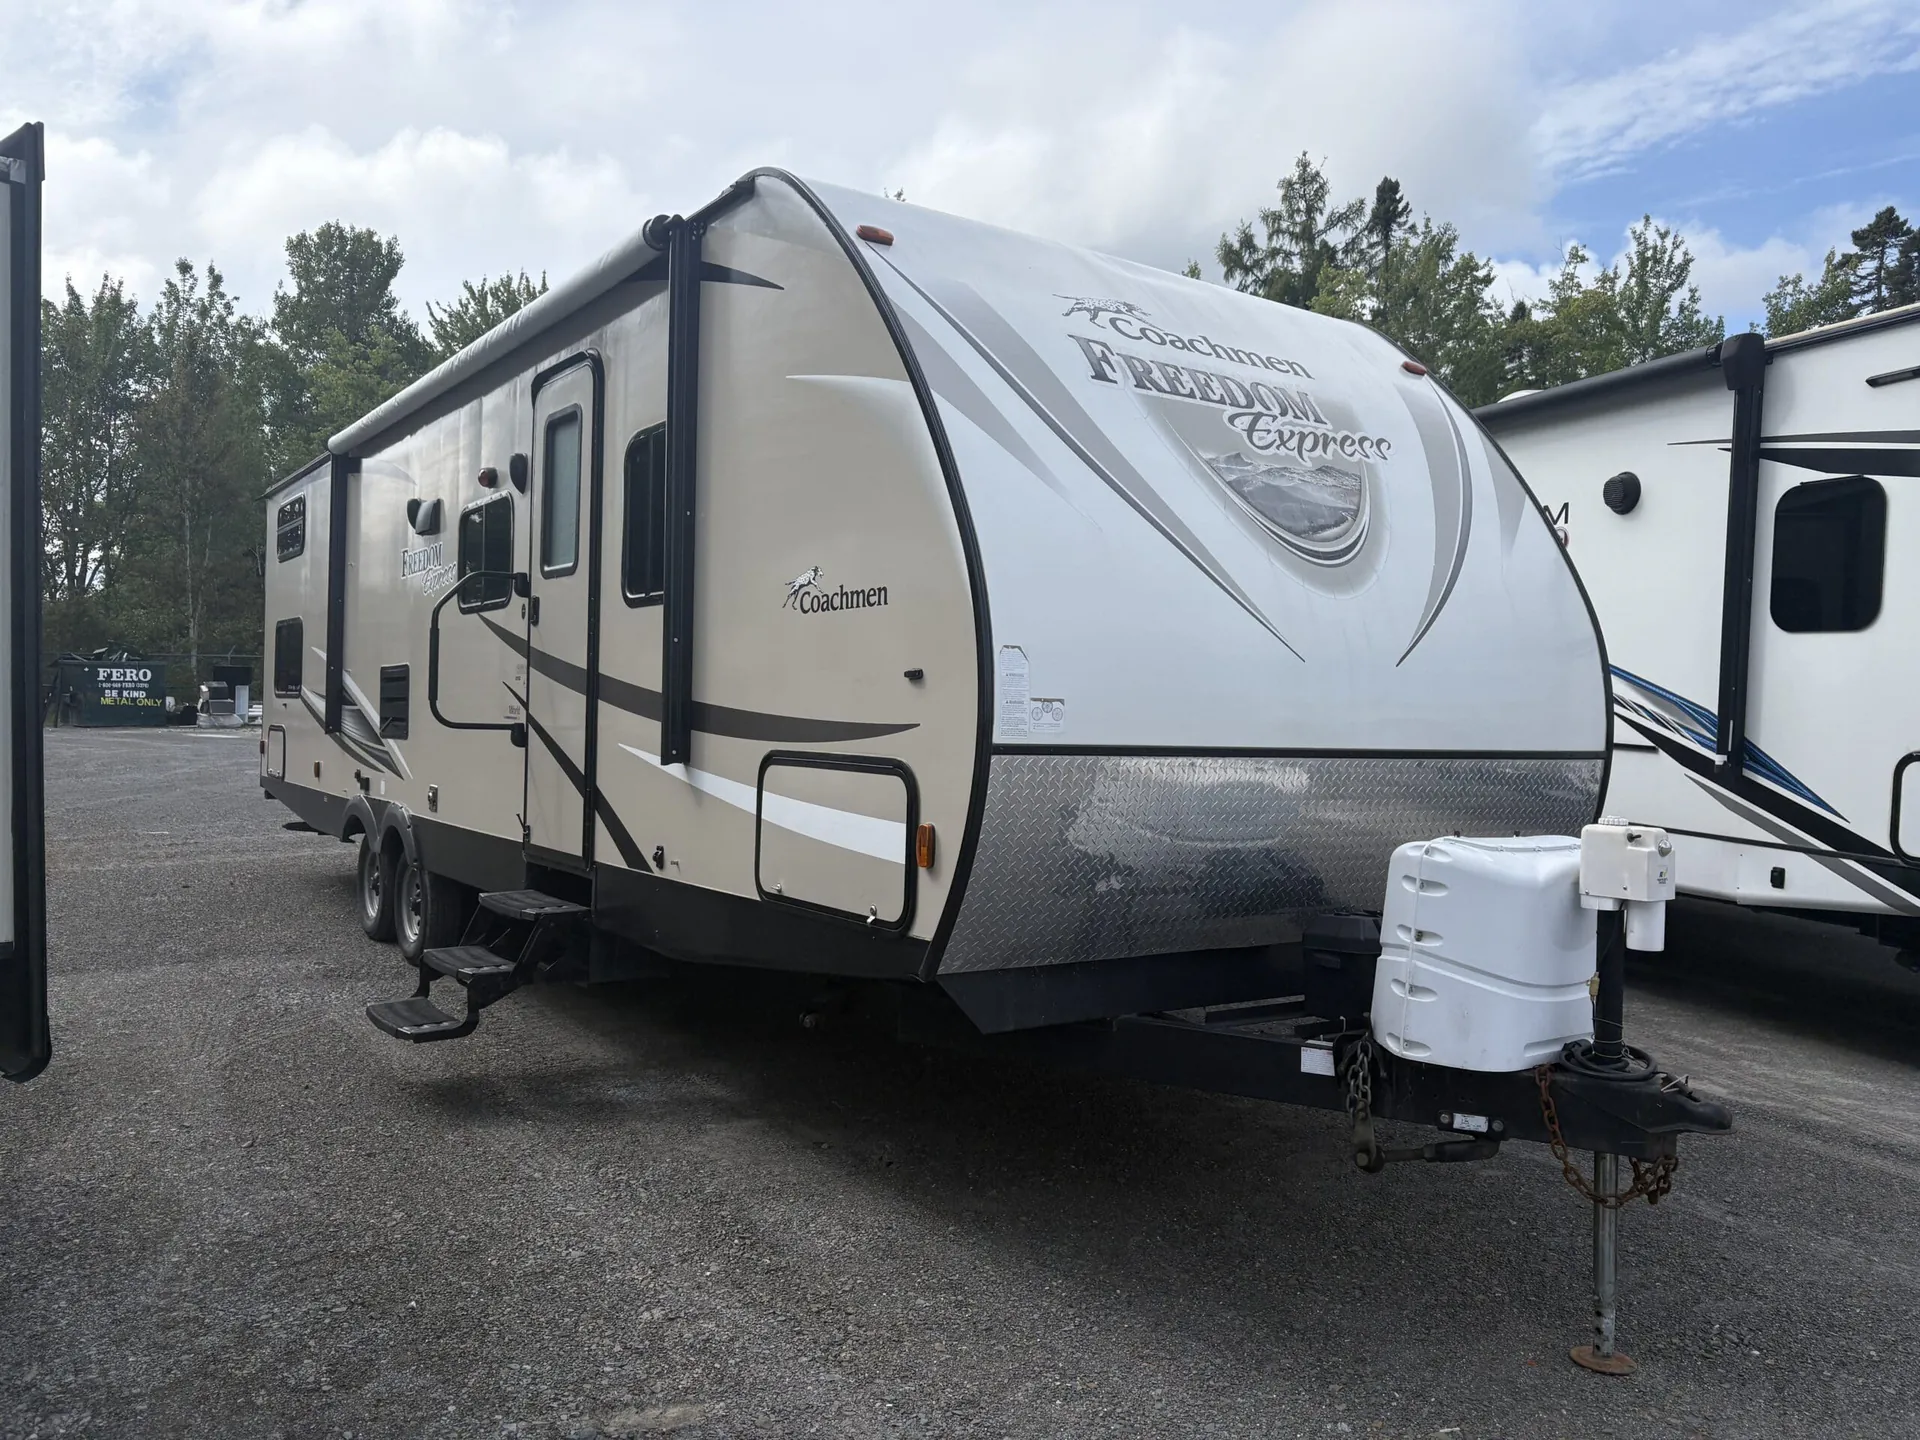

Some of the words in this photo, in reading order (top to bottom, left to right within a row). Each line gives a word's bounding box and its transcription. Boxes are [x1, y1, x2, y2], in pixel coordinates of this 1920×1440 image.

[1109, 316, 1315, 380] Coachmen
[1068, 334, 1329, 426] FREEDOM
[1227, 412, 1392, 463] Express
[401, 543, 442, 578] FREEDOM
[421, 562, 457, 597] Express
[800, 584, 888, 614] Coachmen
[97, 668, 152, 681] FERO
[100, 697, 134, 706] METAL
[136, 698, 162, 707] ONLY
[104, 689, 119, 698] BE
[122, 690, 146, 698] KIND
